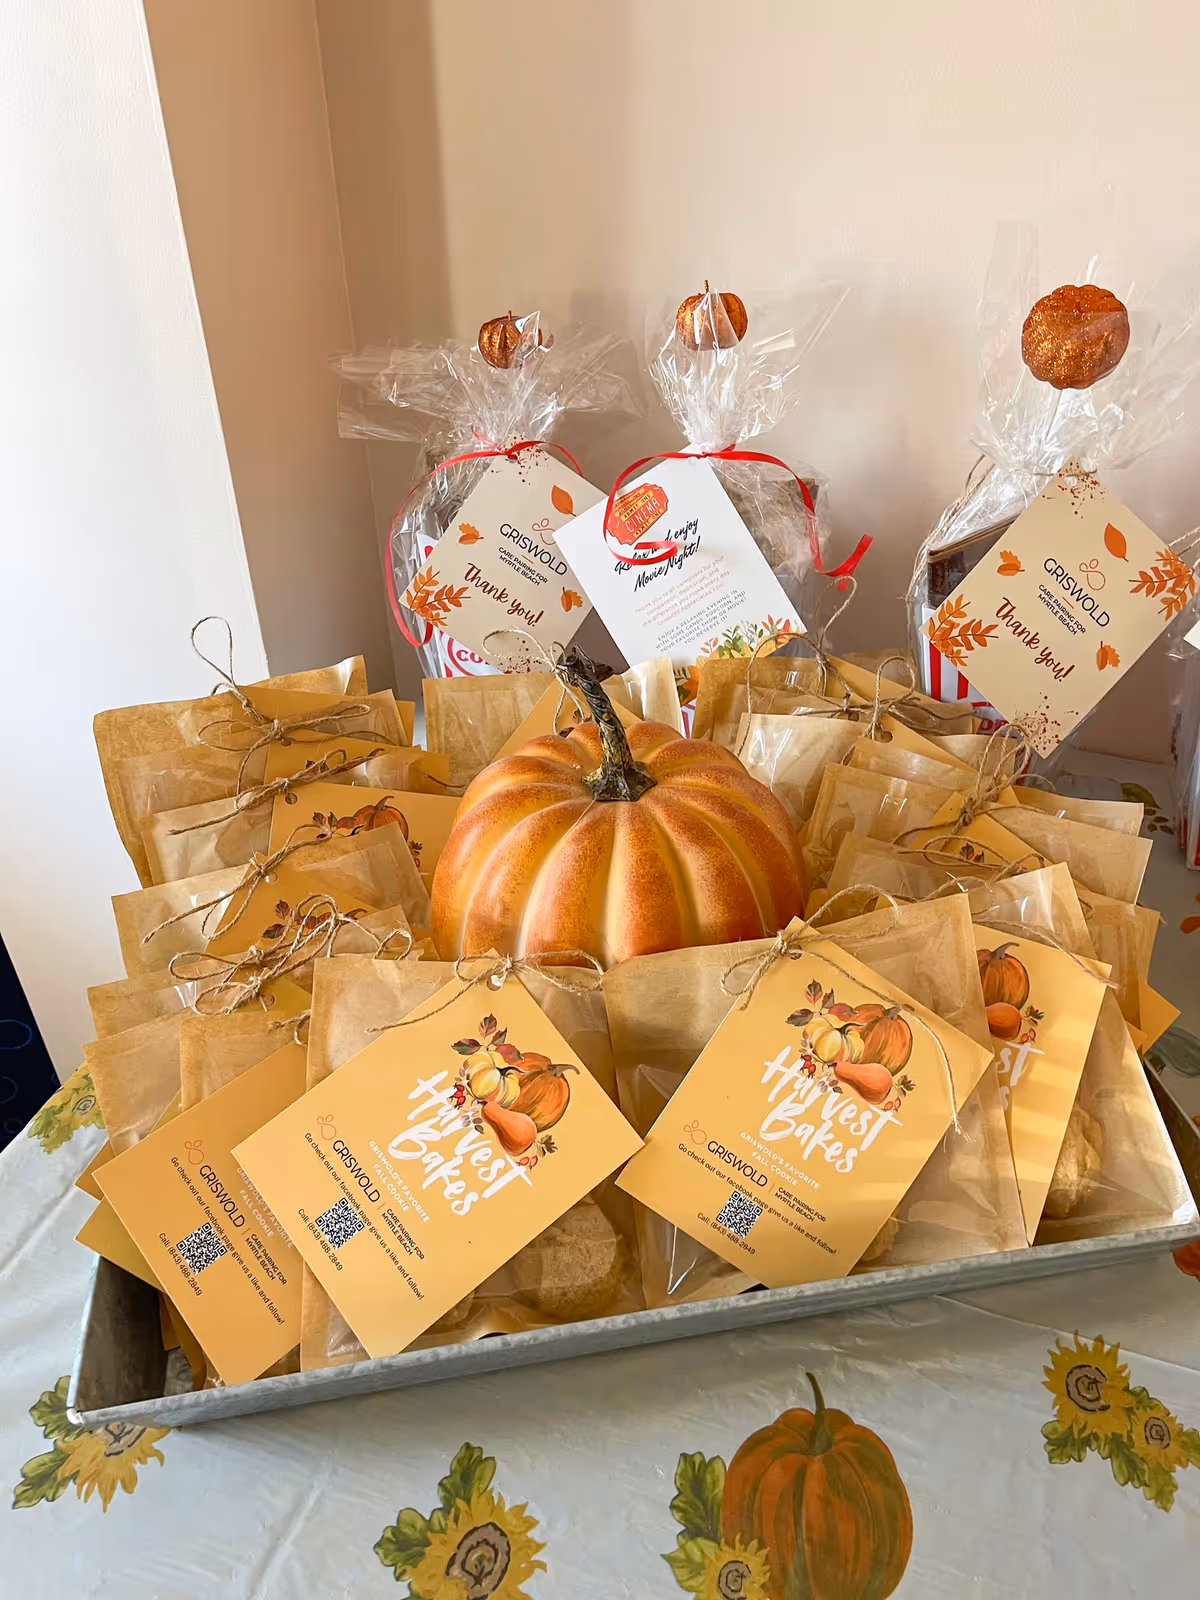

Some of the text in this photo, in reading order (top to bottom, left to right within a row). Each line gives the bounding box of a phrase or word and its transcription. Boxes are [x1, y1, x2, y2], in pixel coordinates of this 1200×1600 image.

[623, 497, 662, 532] CINEMA
[674, 518, 699, 541] enjoy
[498, 547, 548, 584] CARE PAIRING FOR
[499, 555, 541, 586] MYRTLE BEACH
[500, 523, 568, 576] GRISWOLD
[634, 566, 666, 592] Movie
[664, 535, 701, 576] Night!
[464, 562, 545, 627] Thank you!
[1038, 584, 1086, 634] CARE PAIRING FOR
[1038, 593, 1078, 636] MYRTLE BEACH
[1043, 558, 1110, 627] GRISWOLD
[995, 597, 1075, 682] Thank you!
[761, 1045, 904, 1151] Harvest
[407, 1070, 533, 1199] Harvest
[739, 1131, 820, 1189] GRISWOLD'S FAVORITE
[759, 1090, 858, 1173] Bakes
[368, 1140, 430, 1222] GRISWOLD'S FAVORITE
[373, 1164, 409, 1212] FALL COOKIE
[388, 1116, 479, 1217] Bakes
[706, 1141, 826, 1222] GRISWOLD CARE PAIRING FOR
[751, 1151, 798, 1186] FALL COOKIE
[199, 1165, 287, 1285] GRISWOLD CARE PAIRING FOR
[239, 1190, 274, 1238] FALL COOKIE
[304, 1132, 314, 1143] Go
[311, 1142, 326, 1161] check
[323, 1160, 333, 1171] out
[331, 1171, 341, 1182] our
[339, 1181, 361, 1210] facebook
[357, 1210, 371, 1227] page
[369, 1226, 382, 1241] give
[379, 1240, 387, 1248] us
[388, 1252, 400, 1265] like
[397, 1264, 409, 1278] and
[406, 1277, 424, 1300] follow!
[332, 1139, 425, 1260] GRISWOLD CARE PAIRING FOR
[678, 1143, 688, 1152] Go
[686, 1150, 705, 1165] check
[705, 1163, 716, 1172] out
[715, 1170, 726, 1179] our
[725, 1177, 754, 1199] facebook
[752, 1197, 769, 1210] page
[768, 1207, 782, 1219] give
[794, 1223, 806, 1234] like
[805, 1231, 817, 1242] and
[816, 1239, 836, 1255] follow!
[774, 1193, 815, 1222] MYRTLE BEACH
[171, 1157, 180, 1167] Go
[177, 1166, 192, 1185] check
[189, 1185, 199, 1196] out
[196, 1196, 206, 1207] our
[203, 1206, 226, 1235] facebook
[221, 1235, 235, 1252] page
[231, 1250, 245, 1266] give
[242, 1265, 249, 1273] us
[250, 1277, 262, 1290] like
[259, 1289, 270, 1303] and
[267, 1302, 285, 1325] follow!
[245, 1238, 275, 1280] MYRTLE BEACH
[297, 1208, 344, 1271] Call: (843) 488-2849
[381, 1212, 413, 1255] MYRTLE BEACH
[697, 1213, 756, 1255] Call: (843) 488-2849
[158, 1233, 203, 1296] Call: (843) 488-2849
